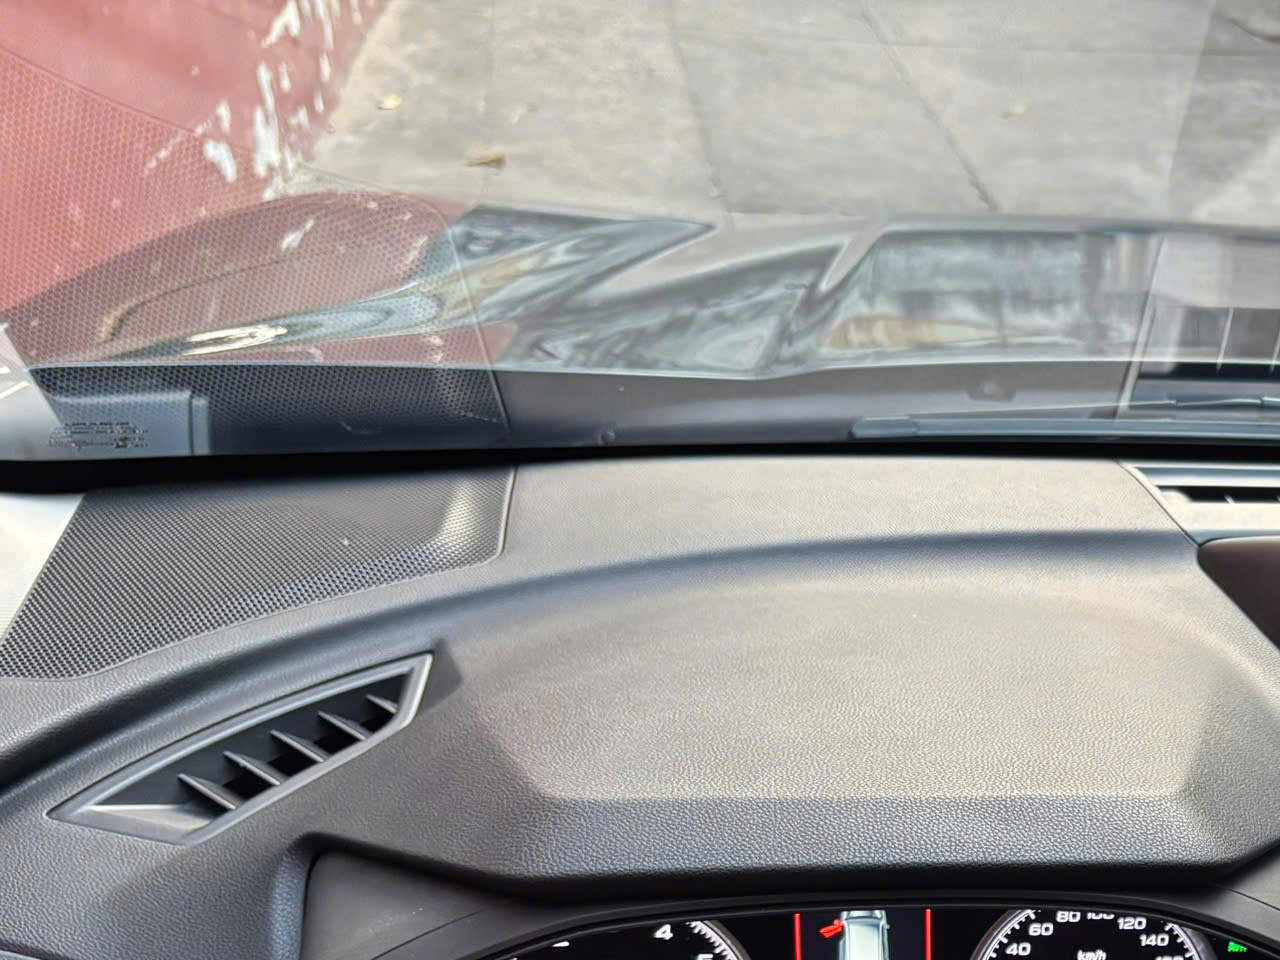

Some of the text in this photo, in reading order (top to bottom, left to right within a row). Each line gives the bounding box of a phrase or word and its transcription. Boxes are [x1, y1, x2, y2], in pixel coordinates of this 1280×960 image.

[1056, 911, 1081, 923] 80
[1028, 923, 1054, 936] 60
[1117, 917, 1147, 931] 120
[654, 923, 673, 940] 4
[1139, 933, 1169, 946] 140
[1006, 942, 1031, 956] 40
